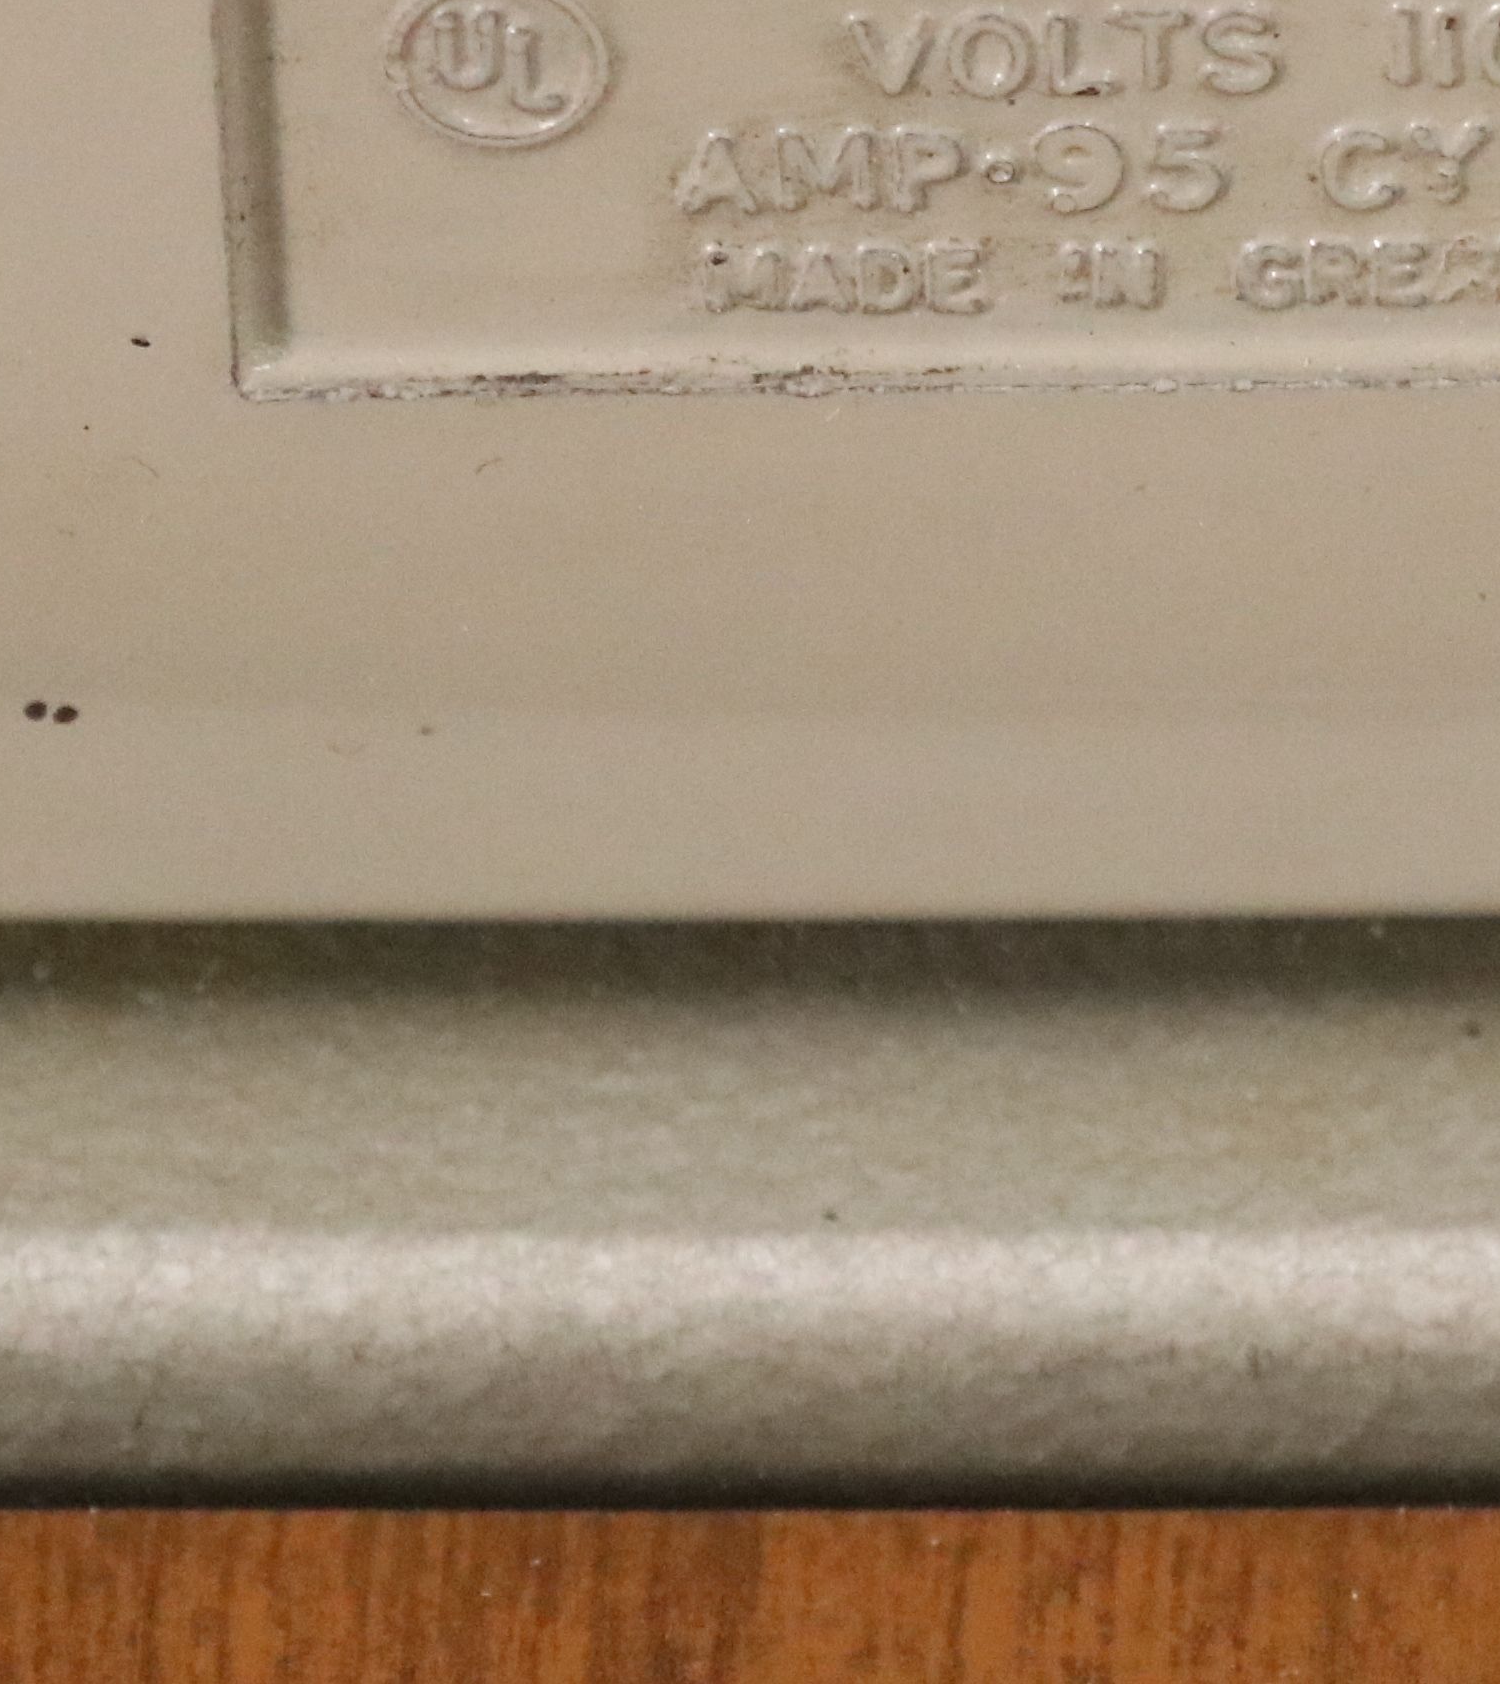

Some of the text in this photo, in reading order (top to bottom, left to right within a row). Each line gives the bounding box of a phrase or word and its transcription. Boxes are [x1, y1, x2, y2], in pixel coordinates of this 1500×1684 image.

[432, 4, 567, 117] UL
[844, 4, 1282, 100] VOLTS
[1320, 122, 1493, 210] CY
[702, 240, 988, 314] MADE
[1056, 238, 1166, 310] IN
